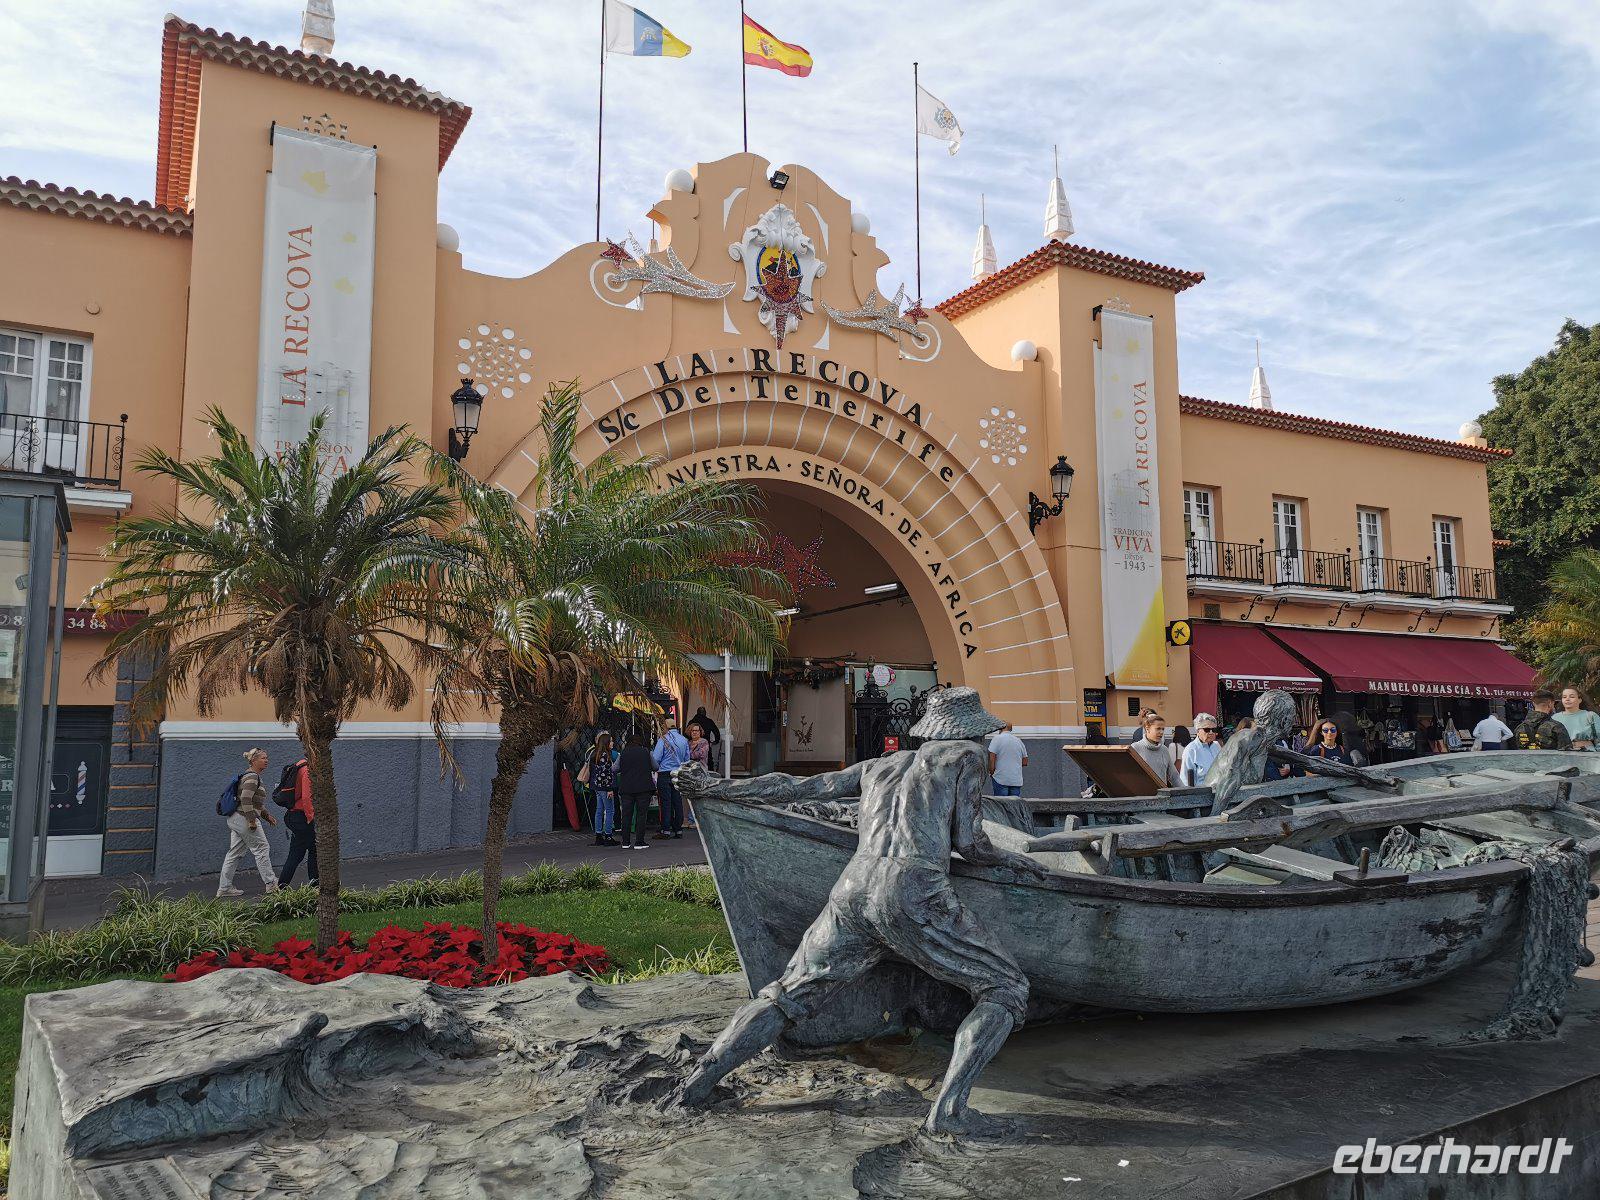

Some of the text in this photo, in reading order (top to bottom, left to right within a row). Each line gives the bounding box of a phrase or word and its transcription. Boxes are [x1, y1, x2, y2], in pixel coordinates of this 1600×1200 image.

[281, 224, 313, 408] LA RECOVA
[653, 348, 922, 427] LA RECOVA
[598, 375, 954, 482] S/c De Tenerife
[1133, 380, 1149, 507] LA RECOVA
[800, 460, 884, 516] SEÑORA
[897, 517, 922, 548] DE
[927, 562, 978, 659] AFRICA
[1113, 535, 1154, 553] VIVA
[1123, 560, 1146, 571] 1943
[67, 617, 86, 629] 34
[1368, 681, 1410, 693] MANUEL
[1412, 683, 1452, 694] ORAMAS
